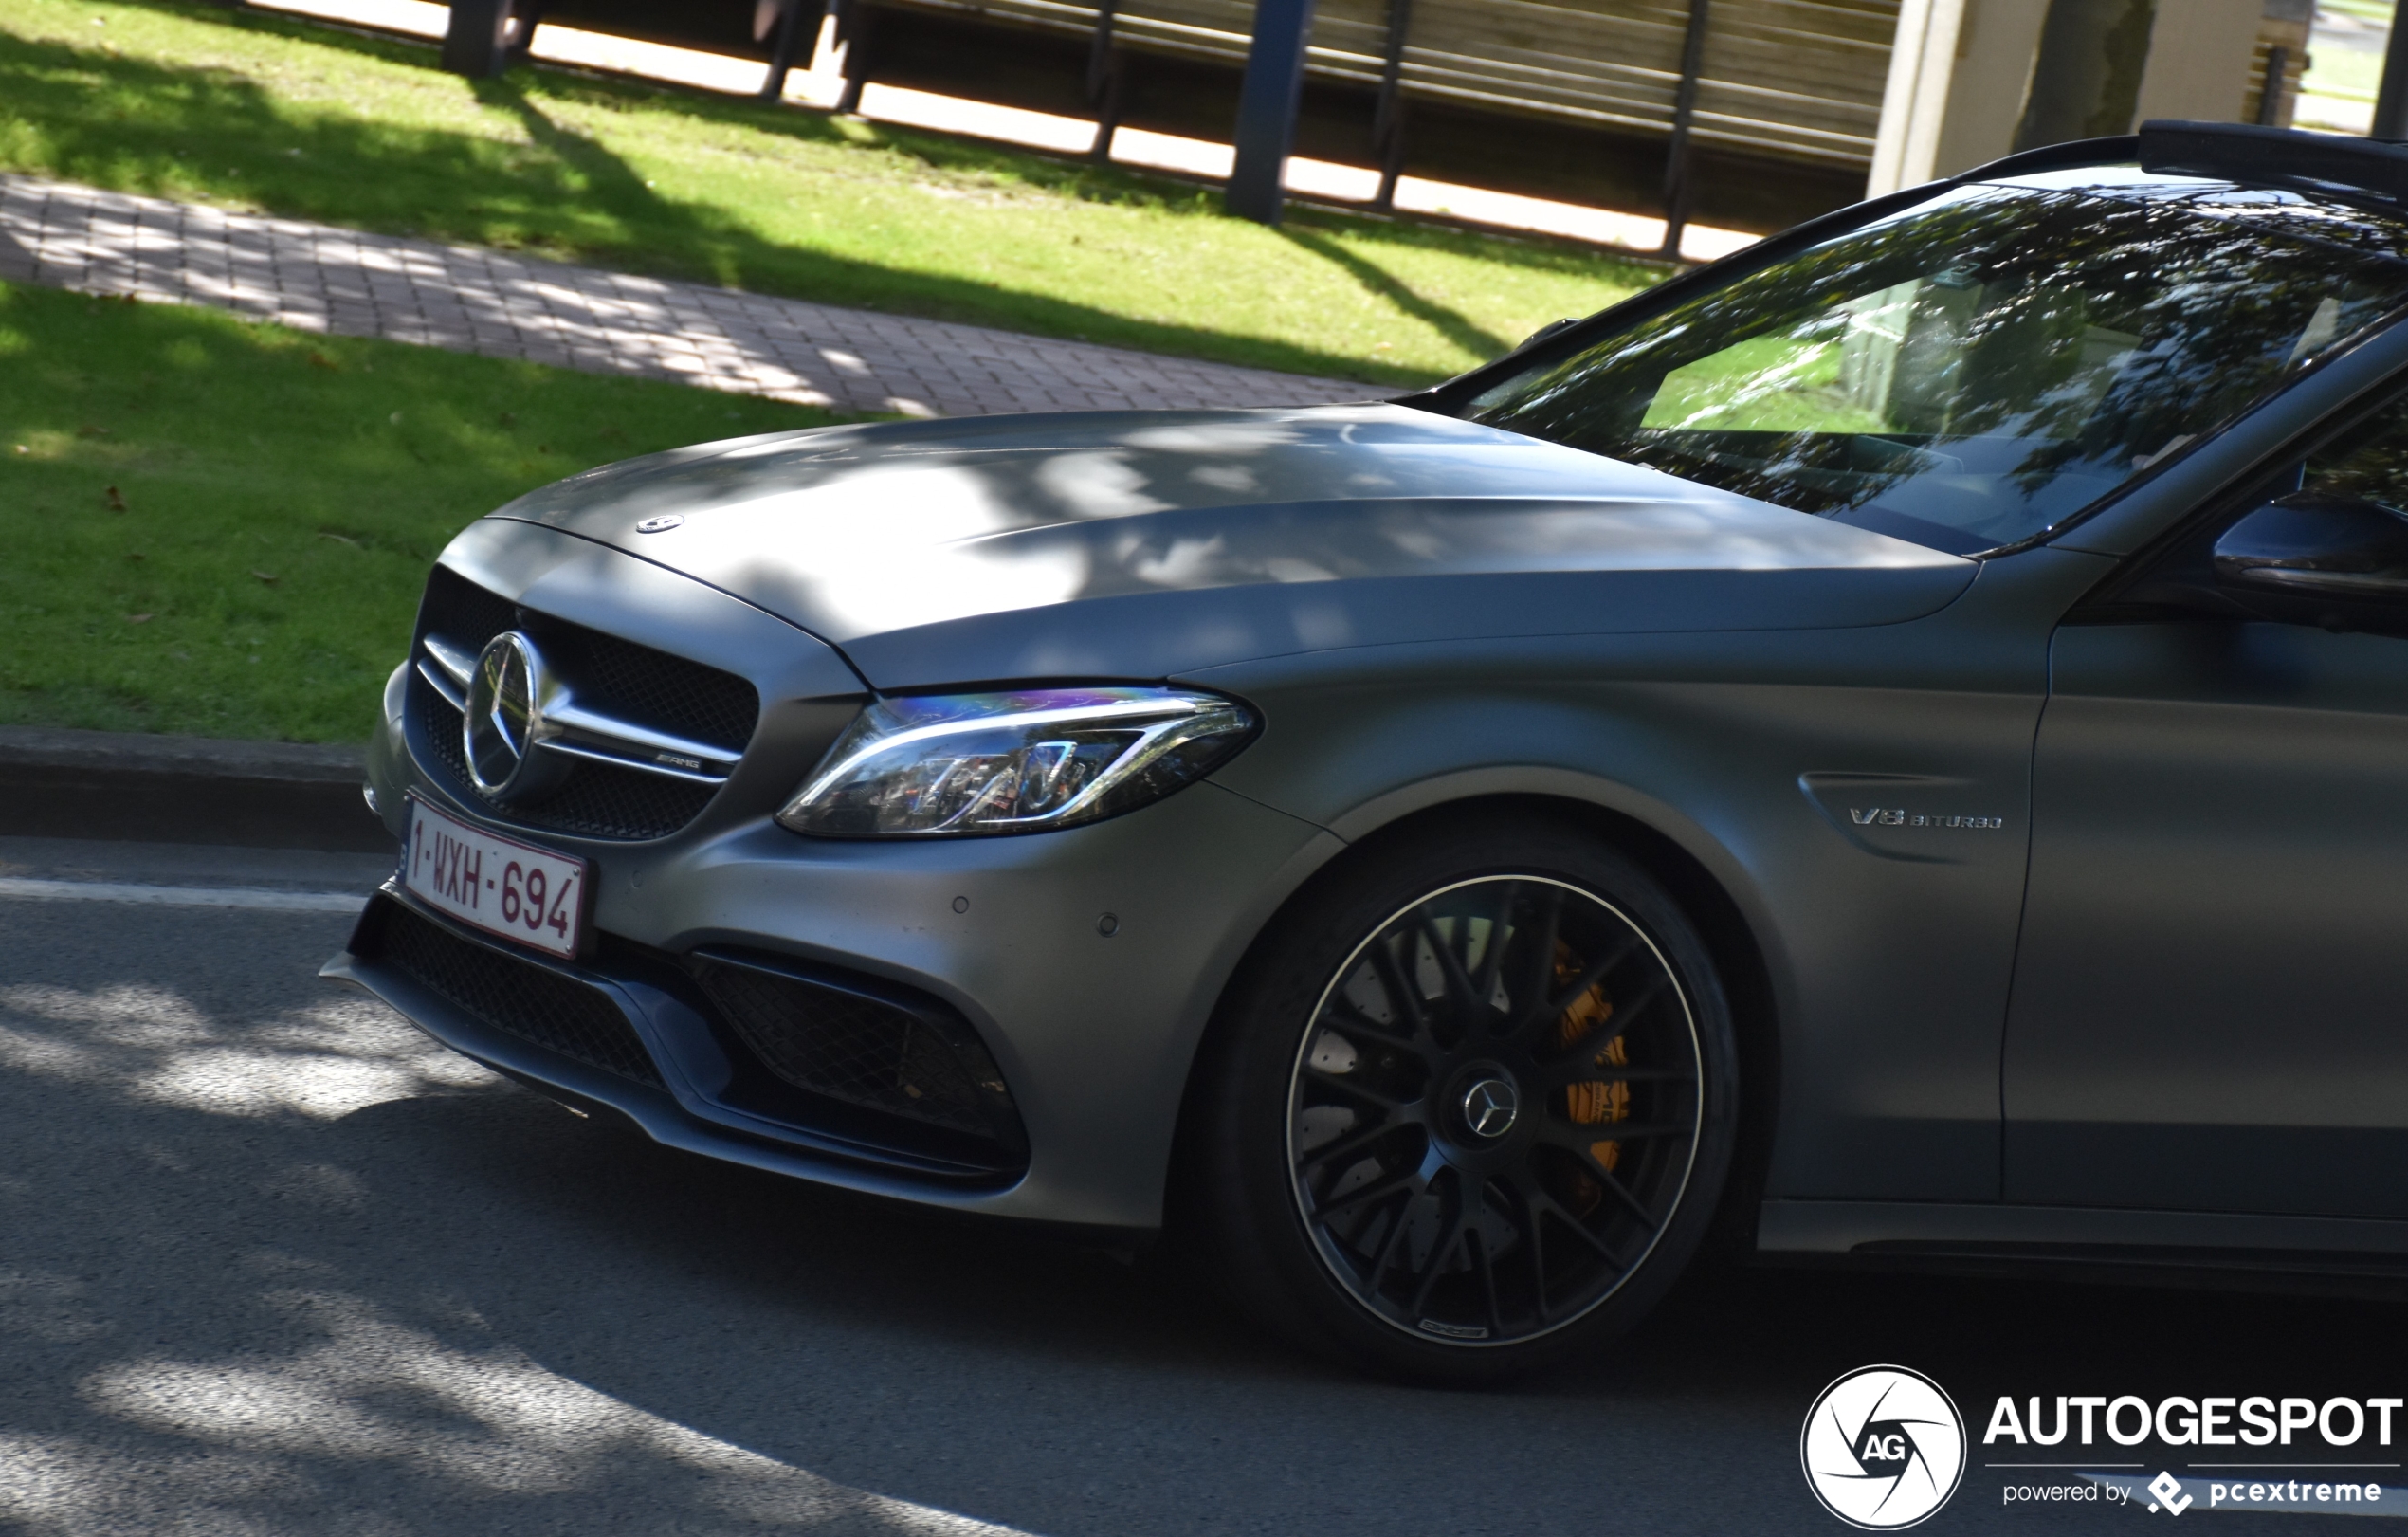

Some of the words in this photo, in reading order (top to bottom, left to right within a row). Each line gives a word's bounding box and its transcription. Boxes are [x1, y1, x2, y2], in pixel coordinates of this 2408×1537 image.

[668, 757, 700, 769] AMG
[1850, 808, 1905, 826] V8
[1909, 814, 2002, 829] BITURBO
[414, 819, 572, 939] 1-WXH-694
